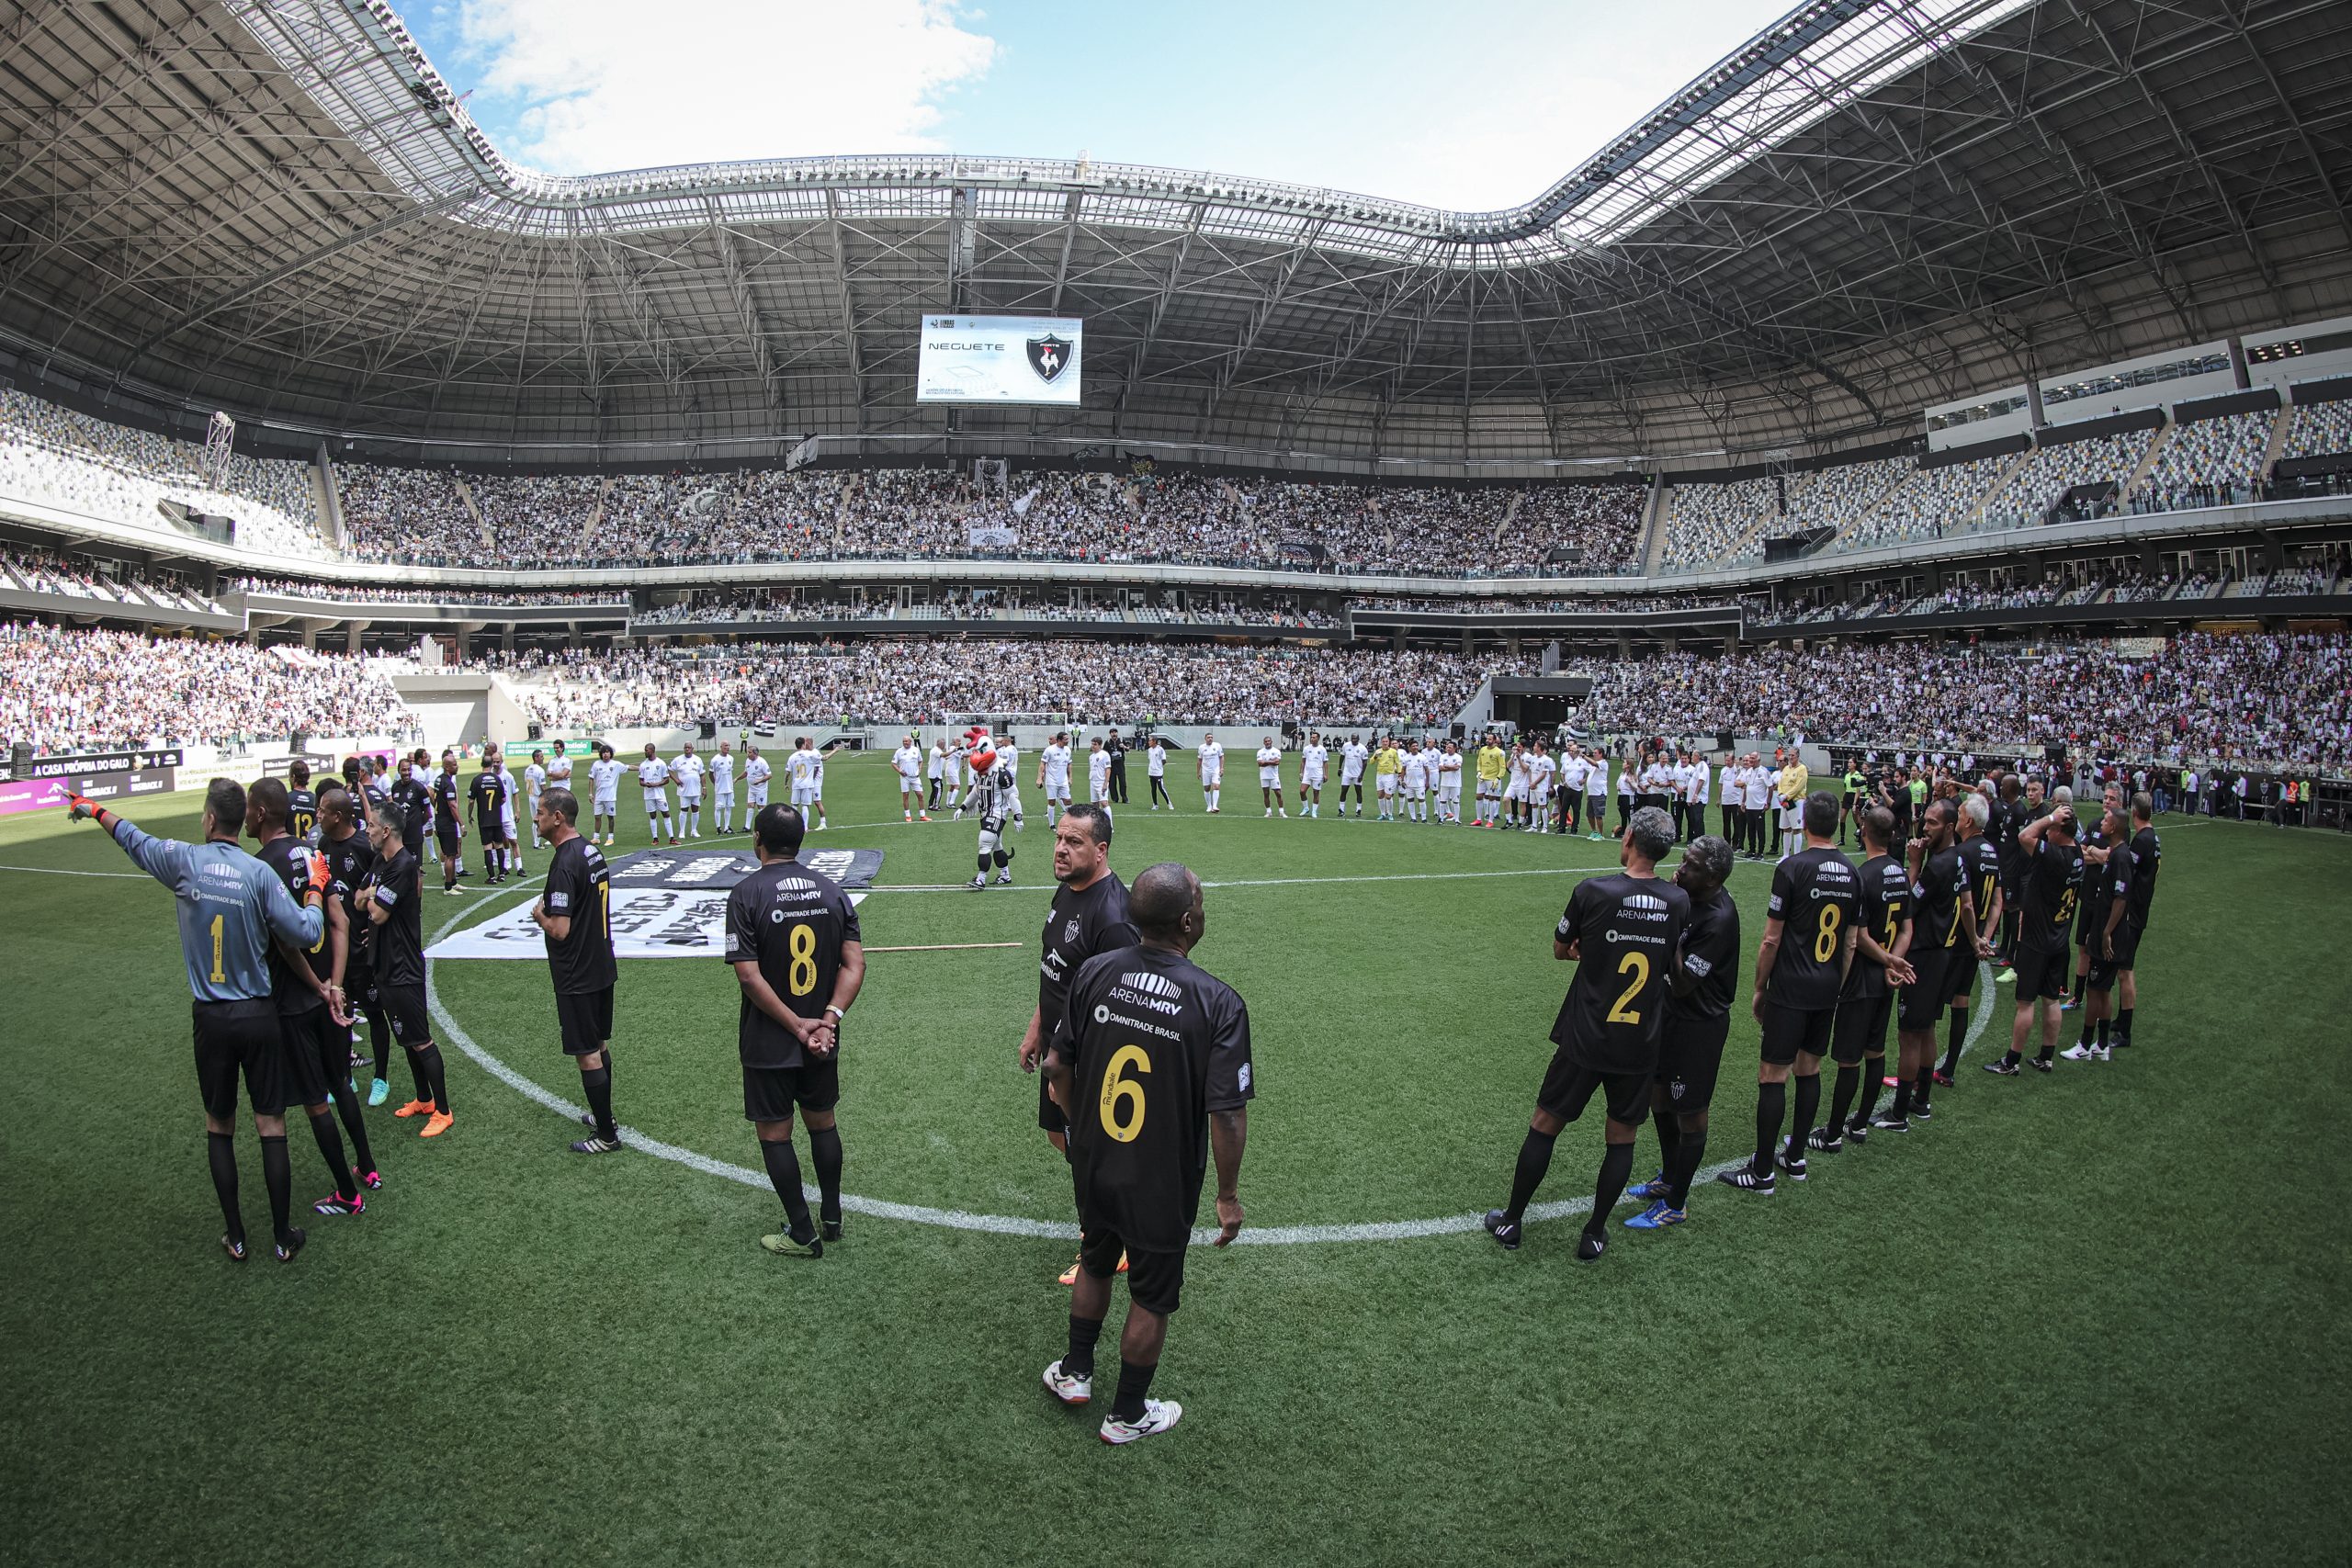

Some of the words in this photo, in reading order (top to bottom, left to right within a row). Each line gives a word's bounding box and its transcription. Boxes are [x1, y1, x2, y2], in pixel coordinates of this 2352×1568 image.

[929, 343, 1005, 351] NEGUETE
[34, 766, 42, 777] A
[42, 764, 63, 776] CASA
[64, 760, 96, 774] PRÓPRIA
[97, 760, 109, 770] DO
[109, 758, 129, 769] GALO
[486, 790, 495, 810] 7
[198, 875, 243, 890] ARENAMRV
[1816, 874, 1851, 883] ARENAMRV
[201, 894, 230, 903] OMNITRADE
[598, 880, 608, 939] 7
[777, 891, 821, 902] ARENAMRV
[1617, 909, 1669, 922] ARENAMRV
[1879, 902, 1901, 953] 5
[1618, 934, 1650, 943] OMNITRADE
[1815, 903, 1841, 962] 8
[211, 914, 225, 983] 1
[790, 924, 817, 996] 8
[1108, 987, 1182, 1016] ARENAMRV
[1606, 951, 1649, 1025] 2
[1109, 1013, 1154, 1033] OMNITRADE
[1154, 1026, 1181, 1042] BRASIL
[1100, 1044, 1151, 1142] 6
[1103, 1072, 1116, 1105] mundiale
